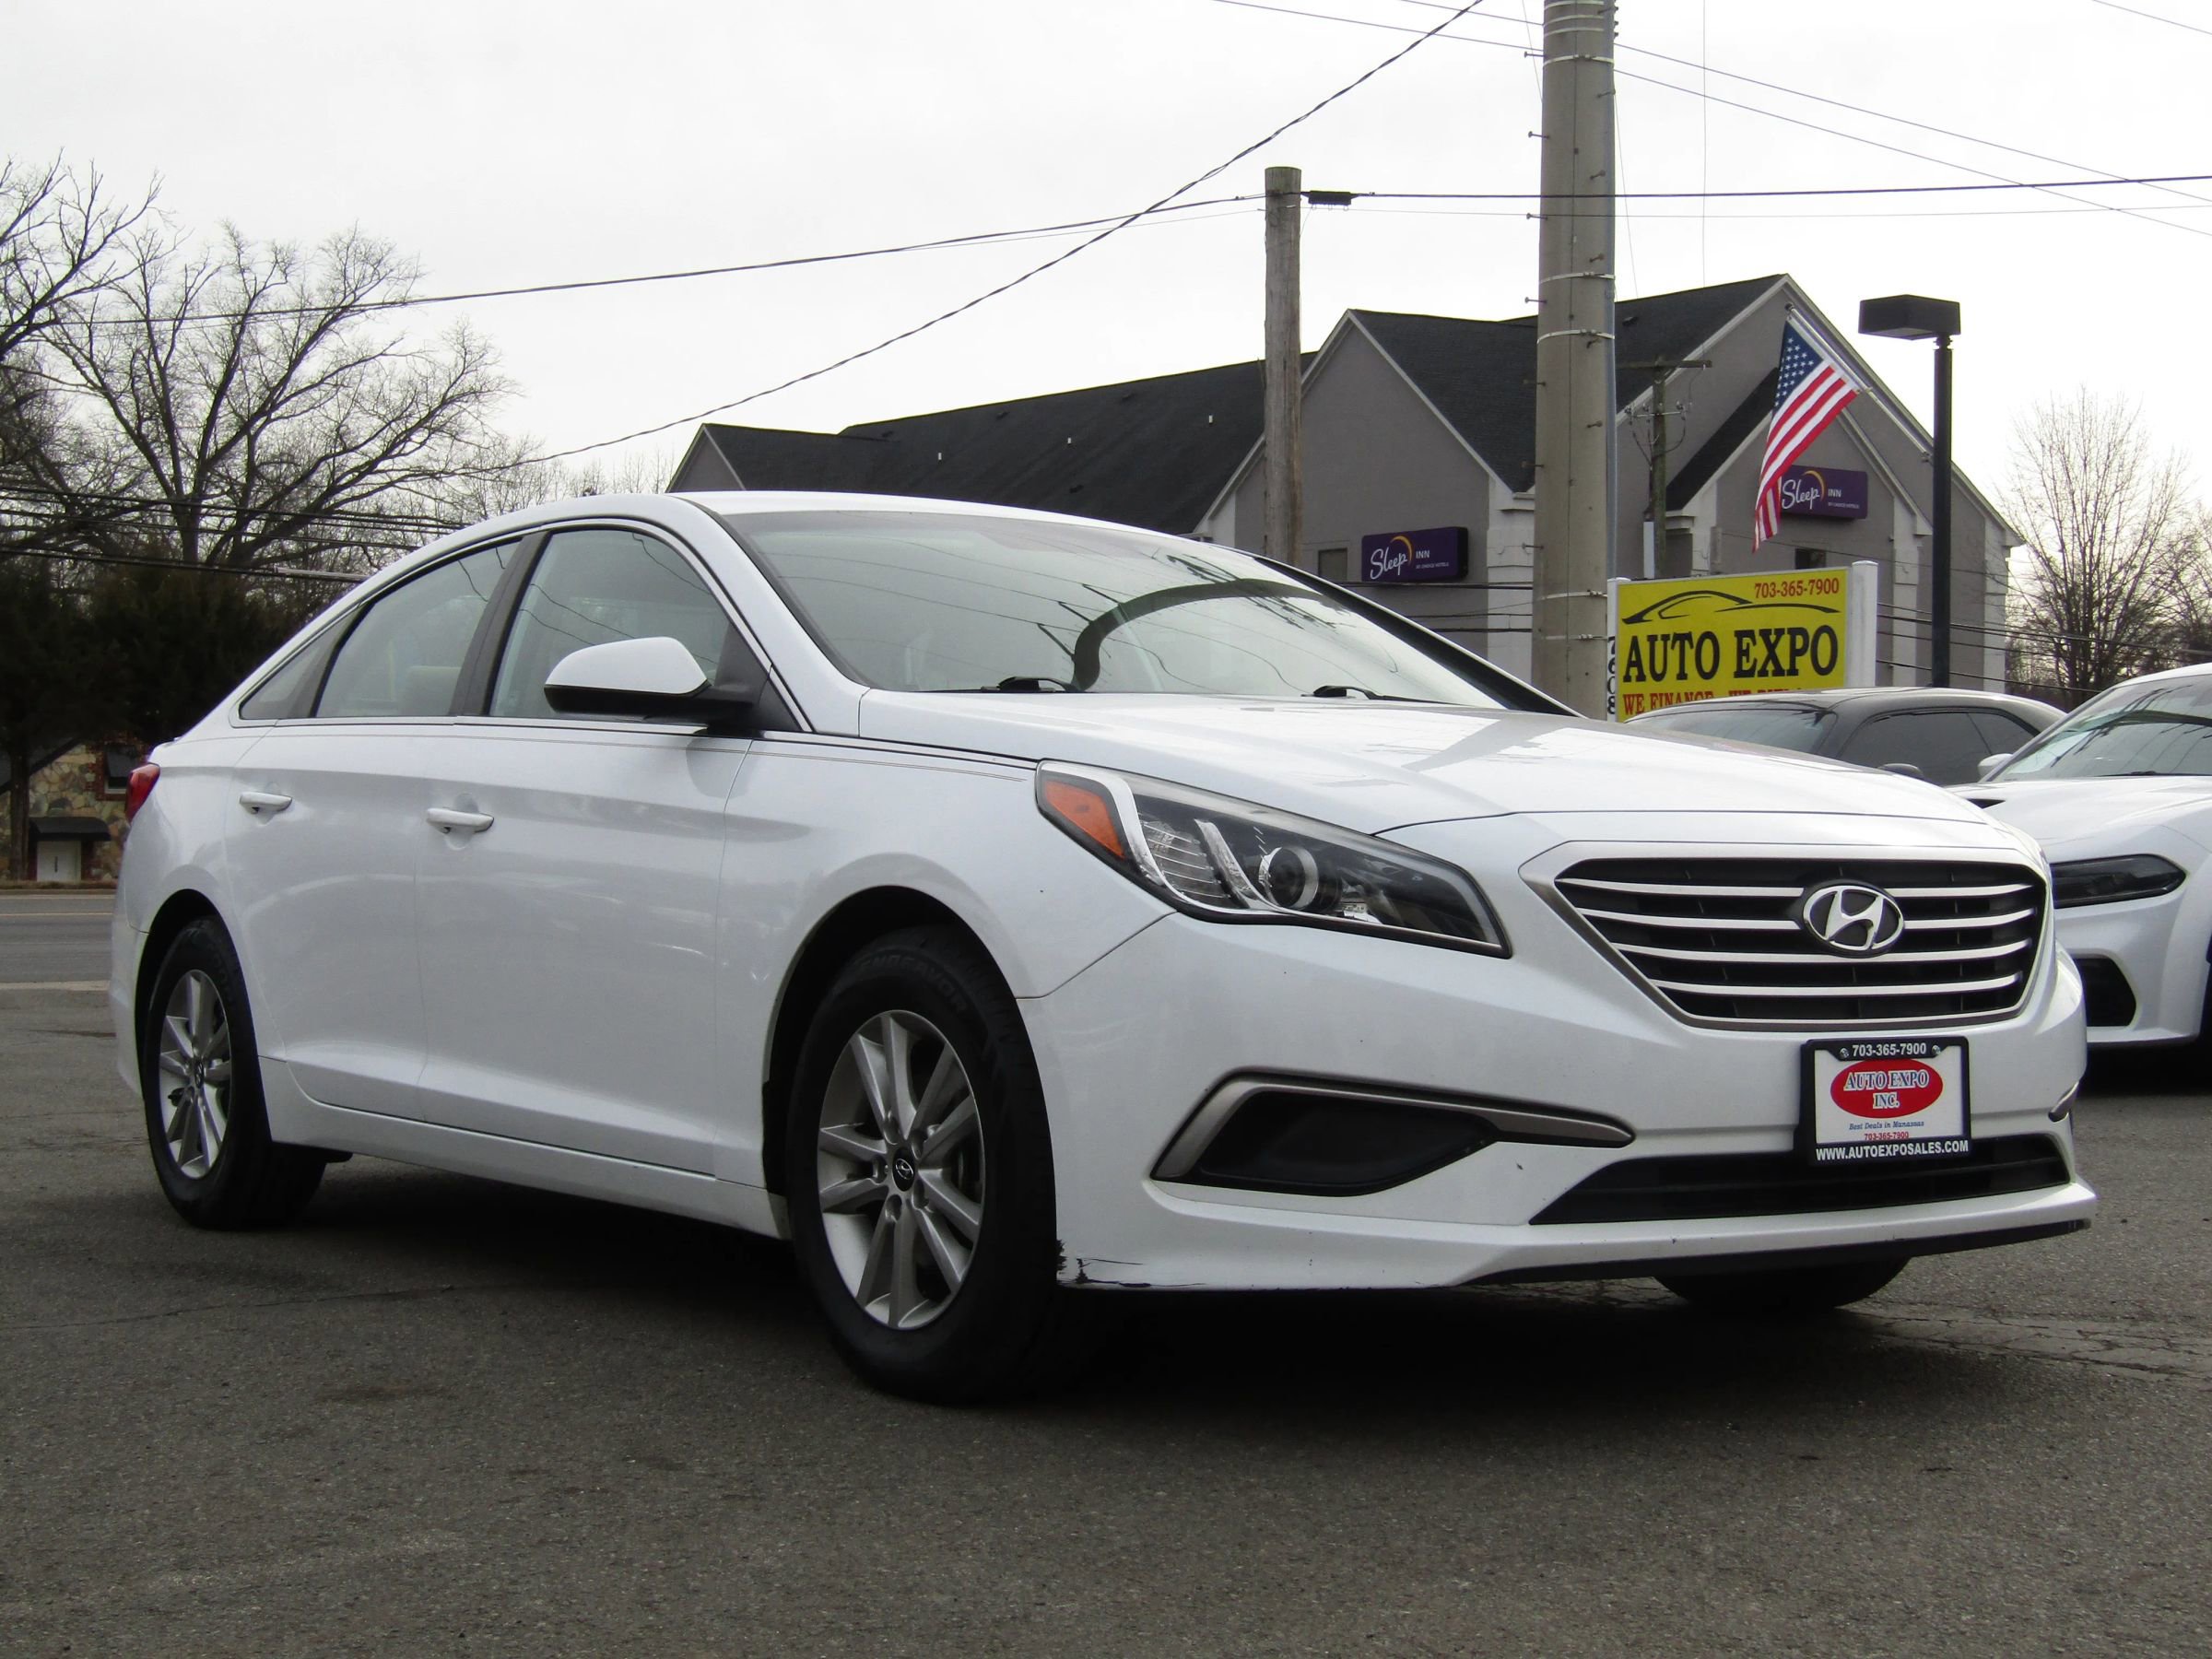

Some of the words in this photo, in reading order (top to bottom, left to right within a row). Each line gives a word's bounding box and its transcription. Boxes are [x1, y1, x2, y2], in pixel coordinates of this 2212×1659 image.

[1782, 479, 1820, 510] Sleep
[1828, 488, 1841, 498] INN
[1370, 547, 1408, 580] Sleep
[1416, 550, 1430, 559] INN
[1754, 577, 1840, 598] 703-365-7900
[1622, 630, 1721, 683] AUTO
[1734, 625, 1839, 679] EXPO
[1622, 693, 1644, 715] WE
[1852, 1042, 1927, 1057] 703-365-7900
[1843, 1071, 1888, 1091] AUTO
[1888, 1069, 1929, 1088] EXPO
[1873, 1091, 1900, 1109] INC.
[1865, 1131, 1910, 1140] 703-365-7900
[1816, 1140, 1969, 1160] WWW.AUTOEXPOSALES.COM
